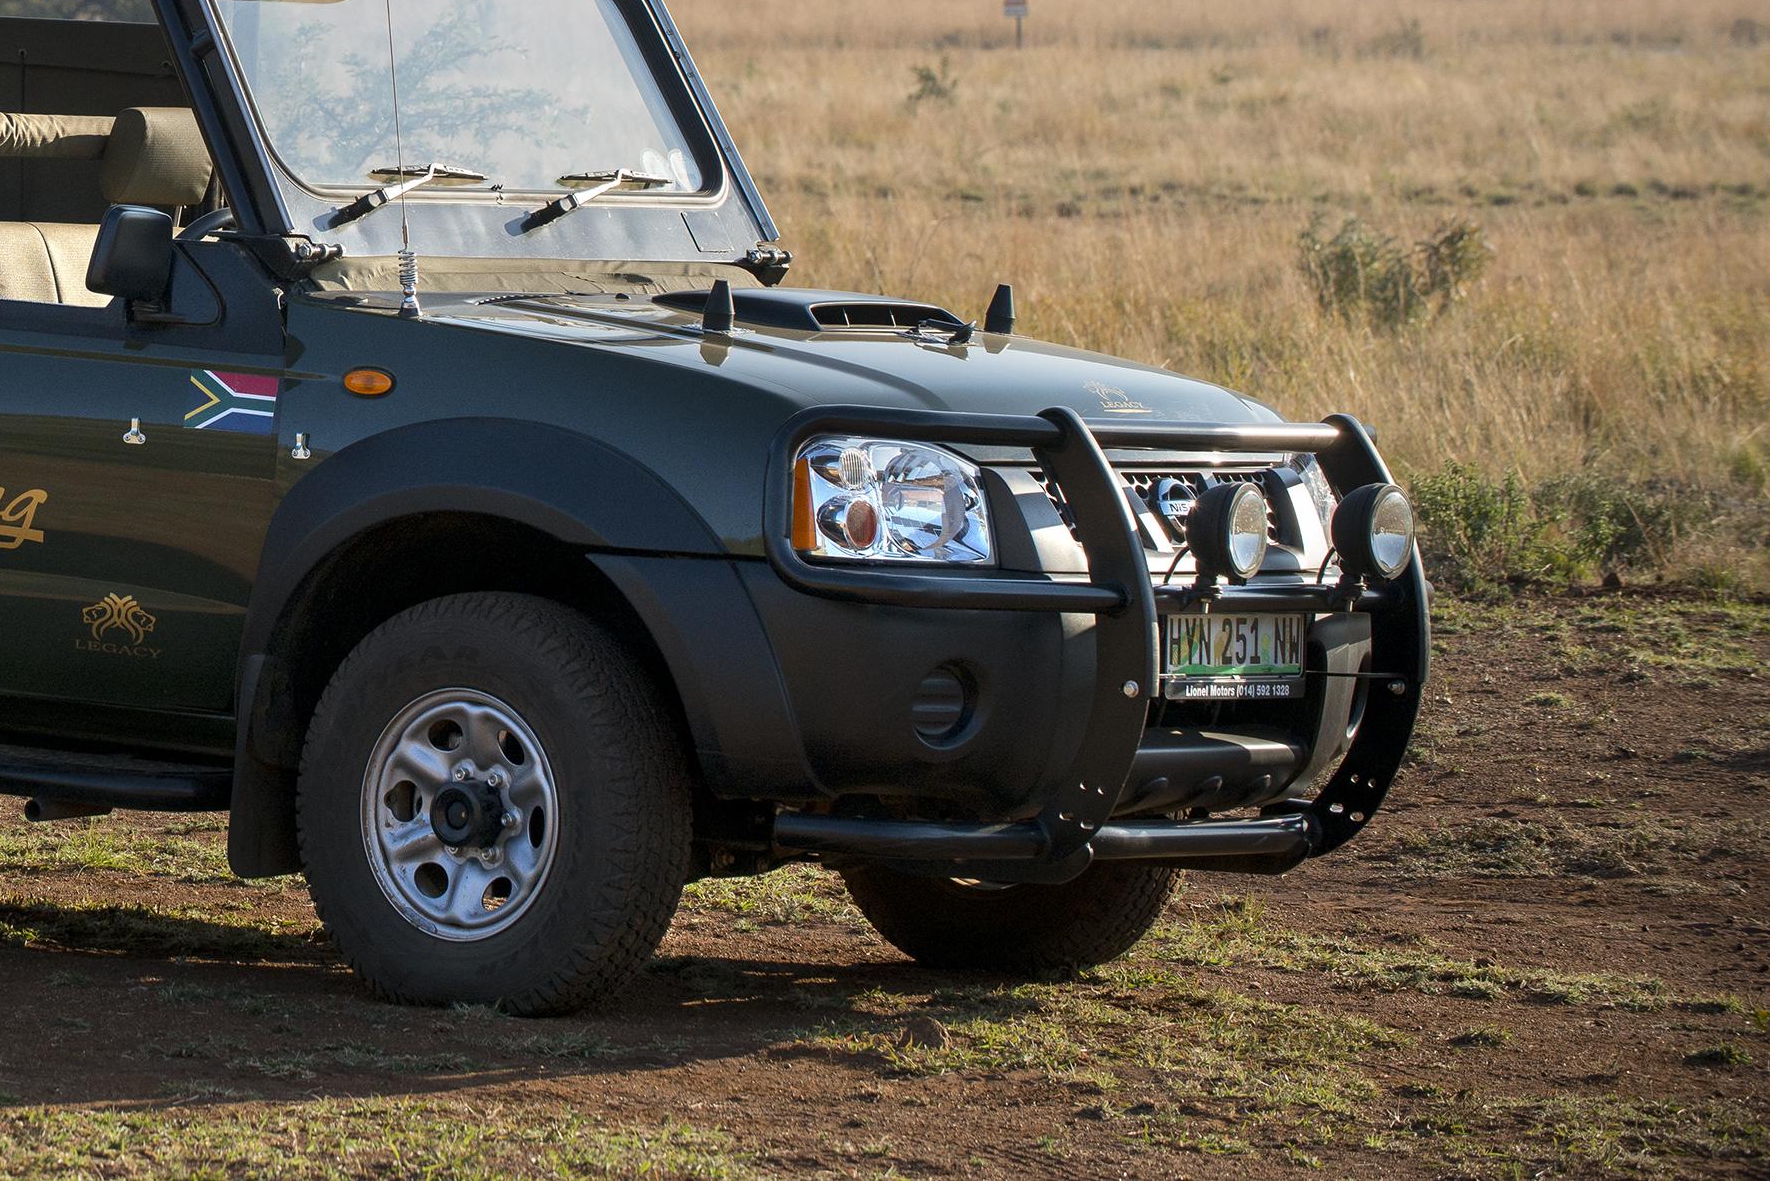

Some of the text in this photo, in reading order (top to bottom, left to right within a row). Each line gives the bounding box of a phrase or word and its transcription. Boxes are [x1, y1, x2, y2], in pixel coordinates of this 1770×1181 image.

[75, 639, 162, 658] LEGACY
[1169, 617, 1299, 666] HYN 251 NW
[1185, 684, 1290, 698] Lionel Motors (014) 592 1328
